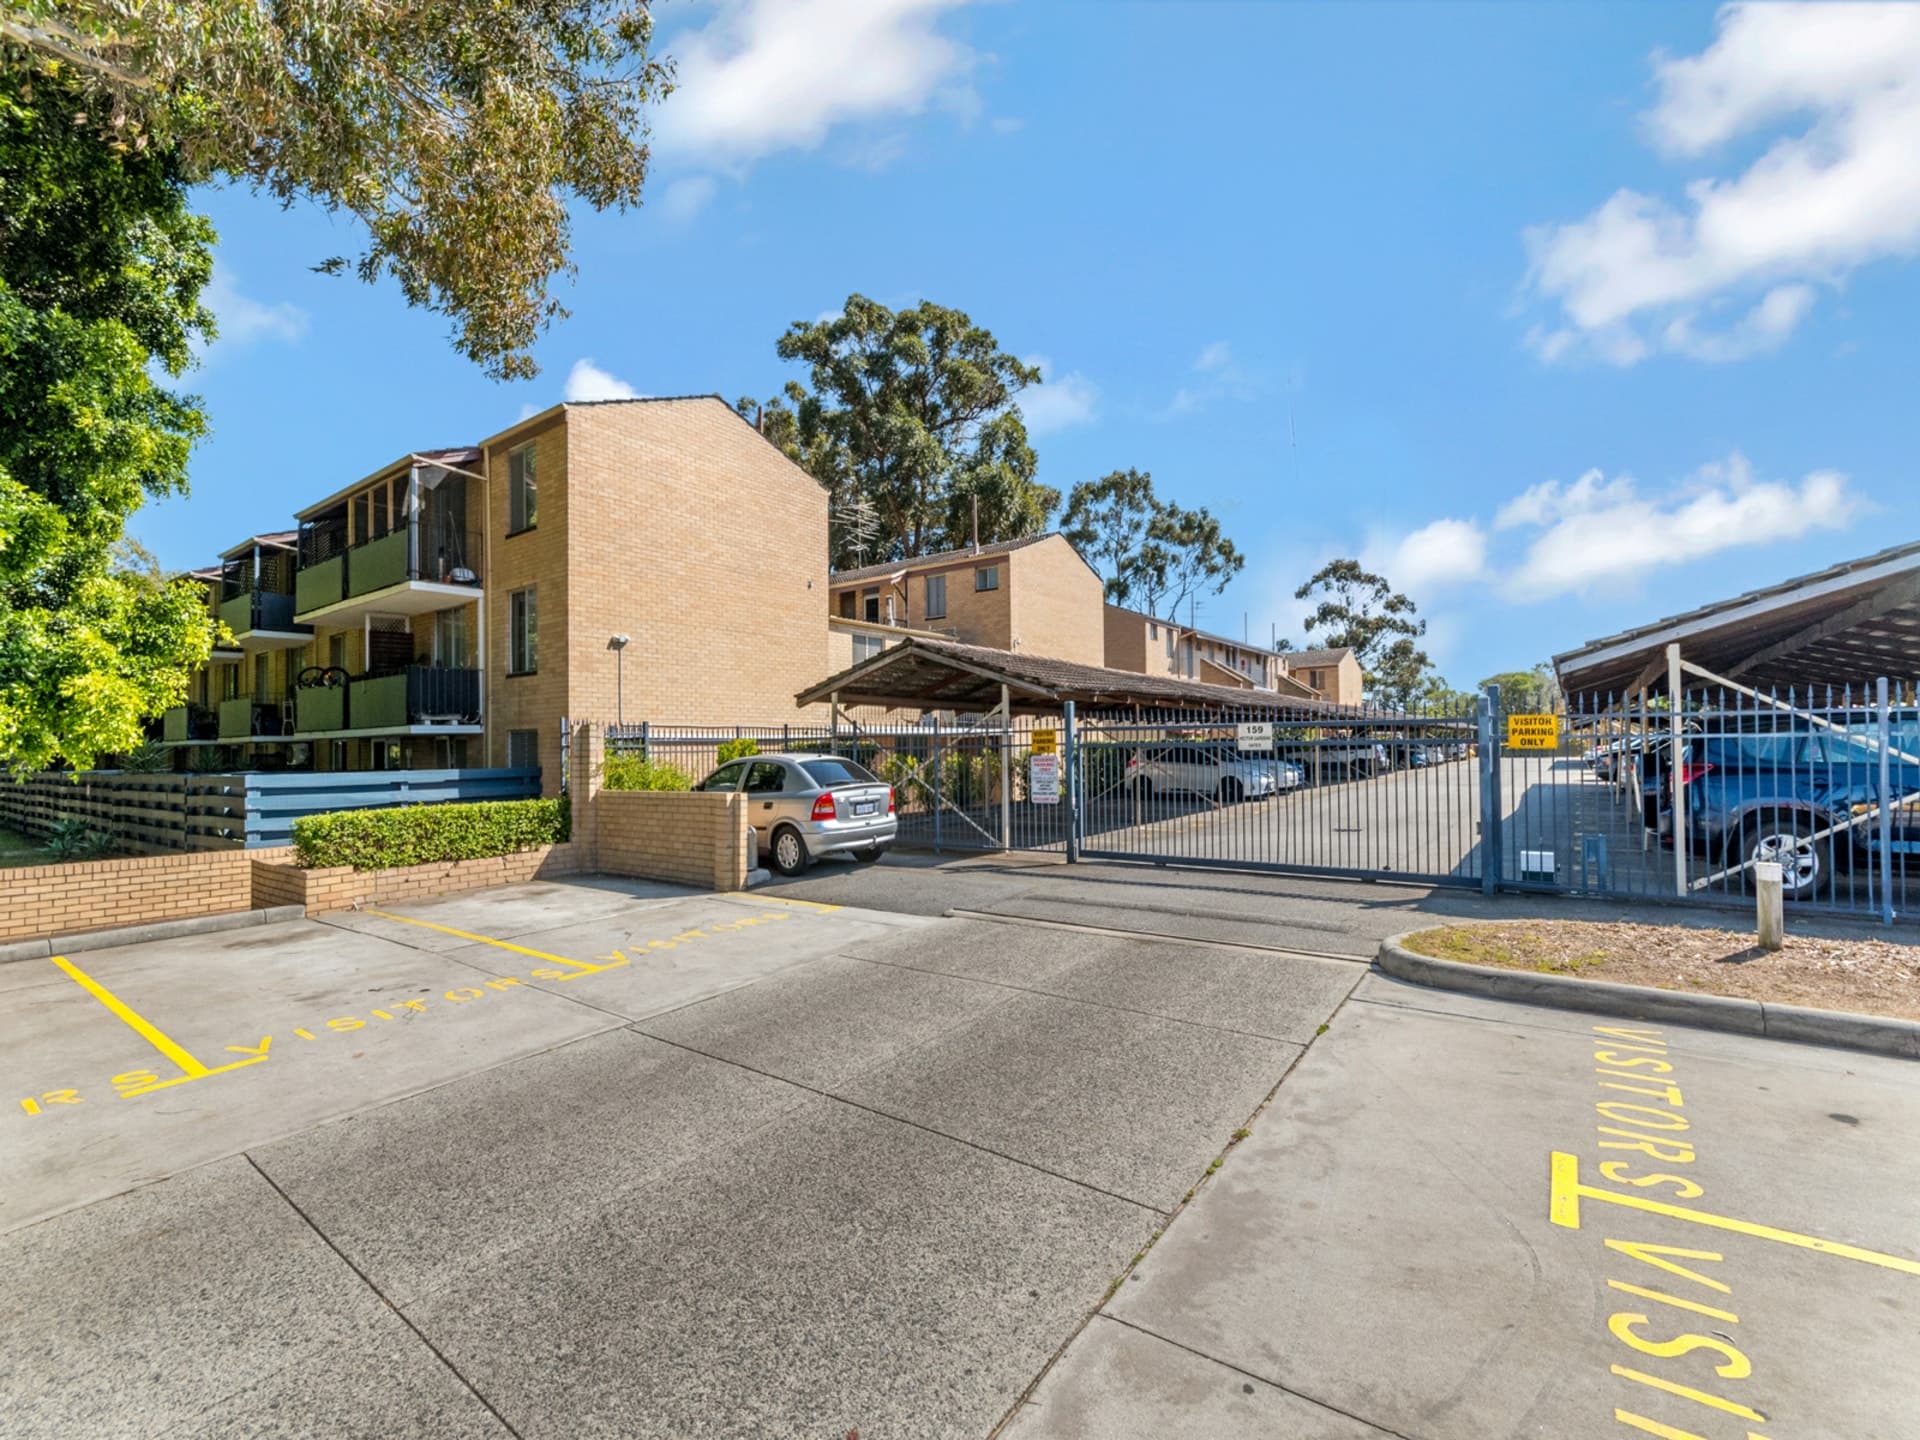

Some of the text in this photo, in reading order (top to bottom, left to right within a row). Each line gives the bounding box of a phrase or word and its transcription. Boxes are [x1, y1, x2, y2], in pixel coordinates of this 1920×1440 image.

[1513, 717, 1552, 726] VISITOR
[1246, 725, 1264, 734] 159
[1511, 728, 1554, 736] PARKING
[1519, 738, 1545, 746] ONLY
[225, 967, 566, 1056] VISITORS
[1592, 1025, 1704, 1199] VISITORS
